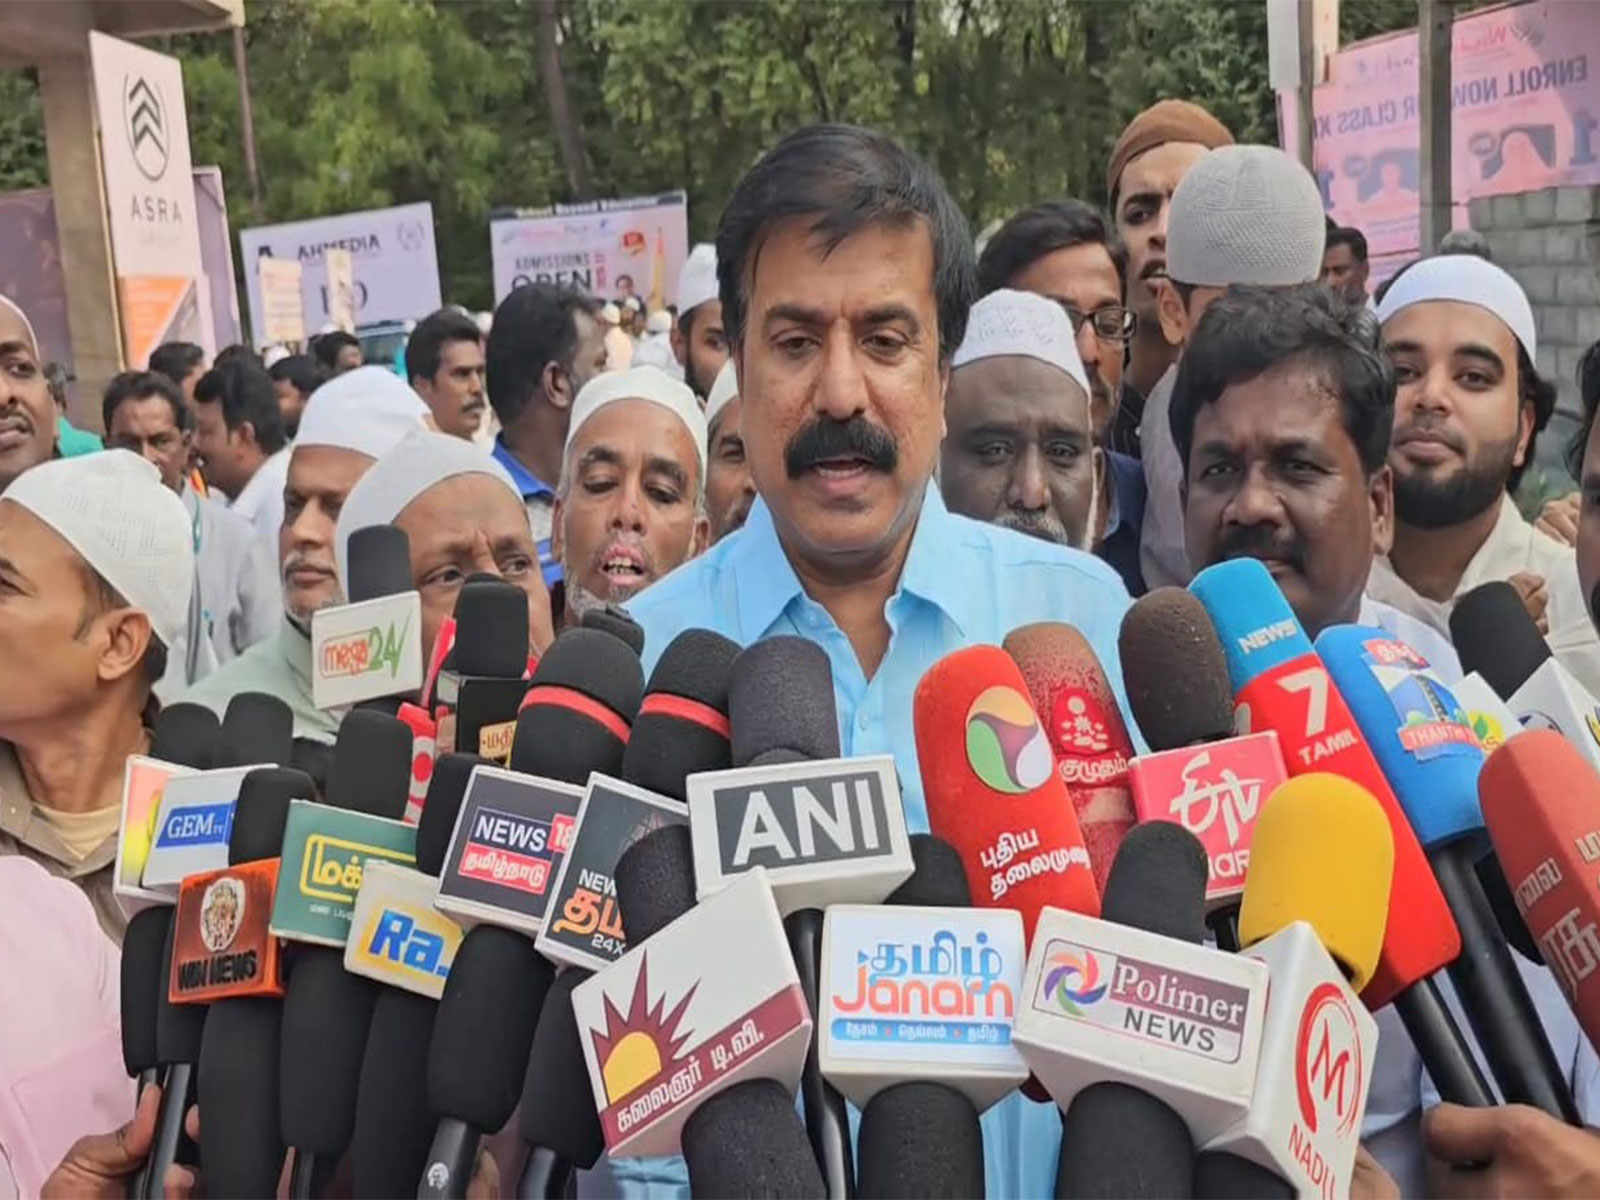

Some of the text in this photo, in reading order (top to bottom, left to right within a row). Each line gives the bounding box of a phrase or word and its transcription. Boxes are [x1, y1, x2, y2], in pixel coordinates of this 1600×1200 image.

[131, 193, 183, 224] ASRA
[515, 252, 591, 270] ADMISSIONS
[1239, 618, 1297, 654] NEWS
[1277, 666, 1328, 737] 7
[1298, 729, 1358, 766] TAMIL
[168, 813, 215, 839] GEM
[474, 815, 548, 853] NEWS
[732, 779, 880, 866] ANI
[980, 828, 1040, 869] புதிய
[869, 930, 1003, 994] தமிழ்
[832, 965, 1014, 1018] Janam
[1113, 961, 1244, 1026] Polimer
[1123, 1007, 1216, 1052] NEWS
